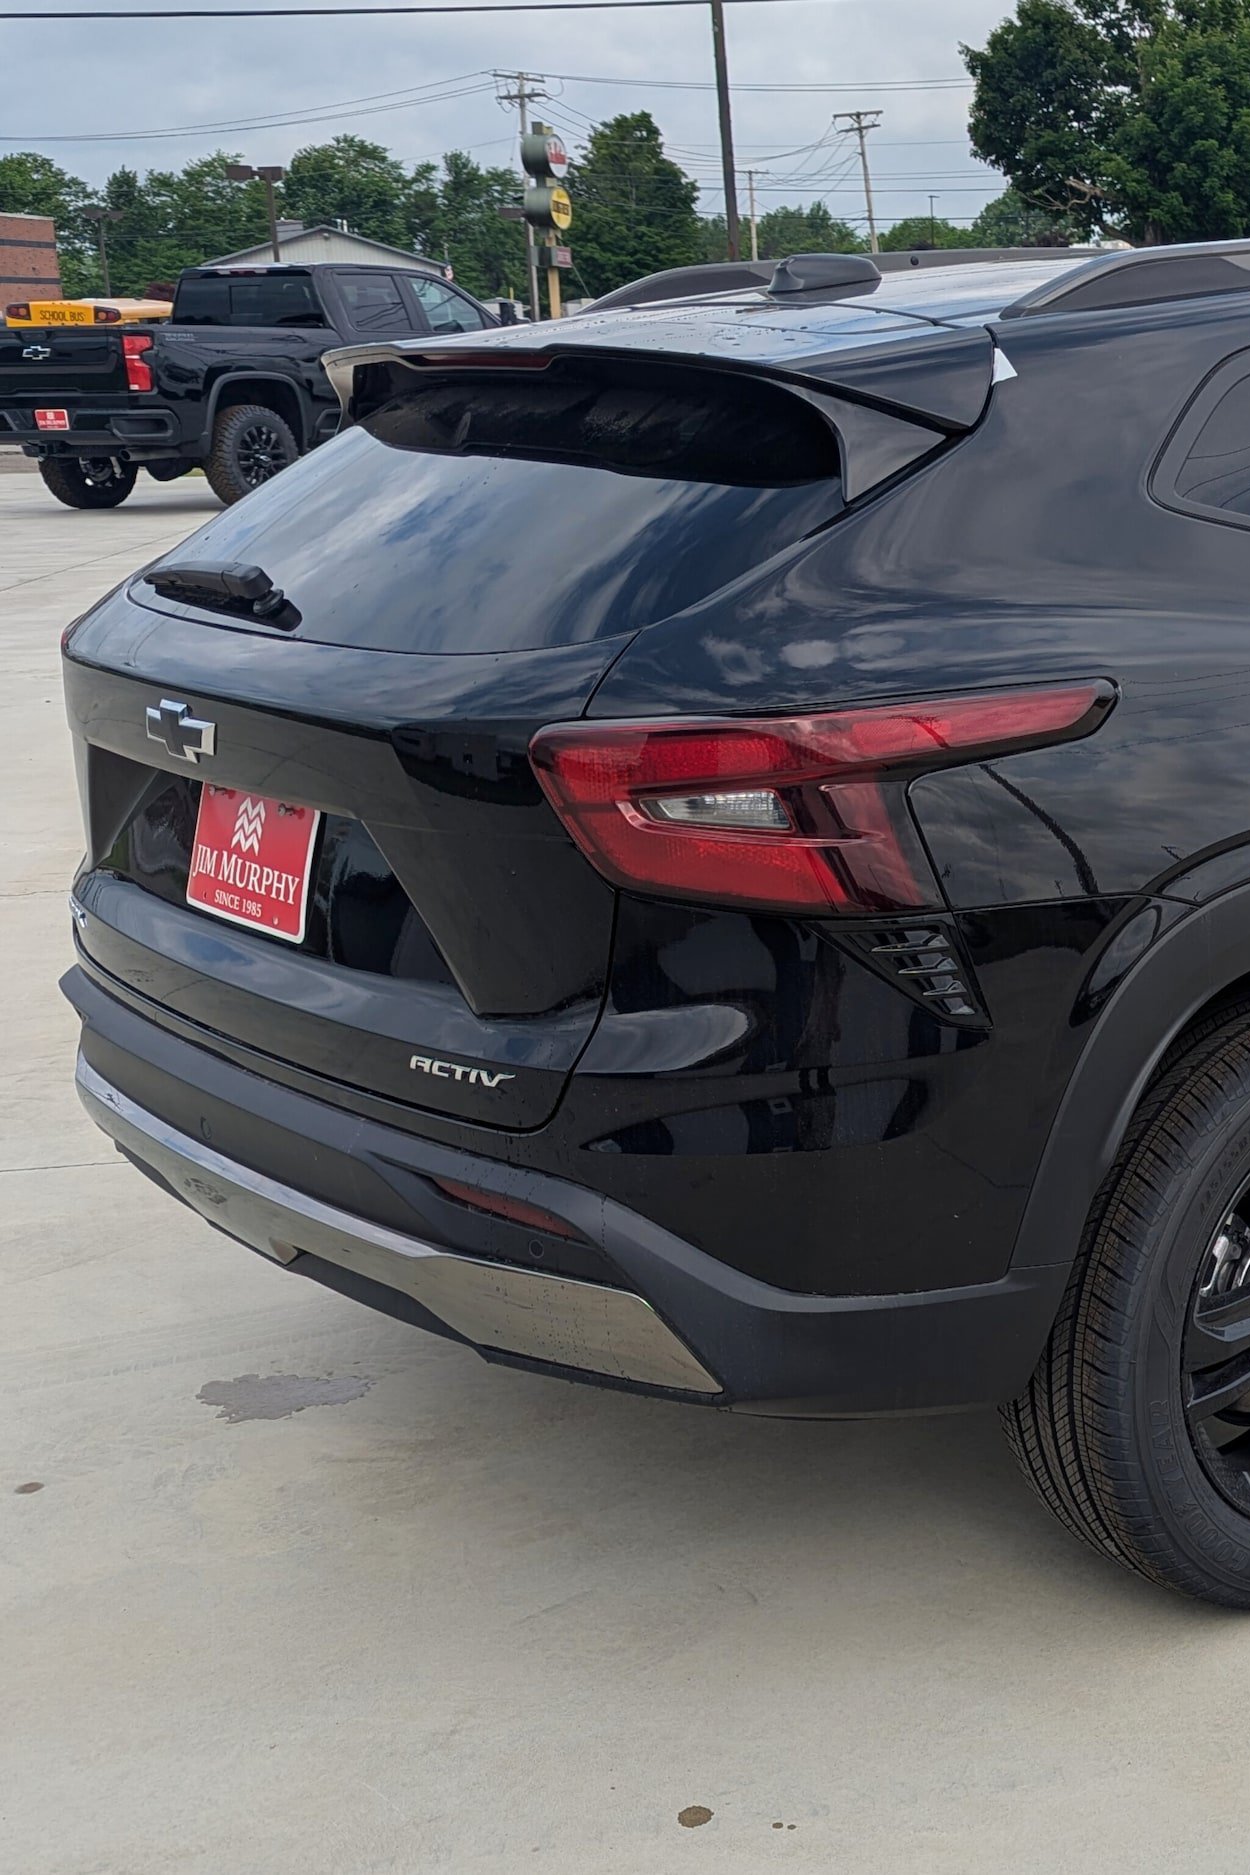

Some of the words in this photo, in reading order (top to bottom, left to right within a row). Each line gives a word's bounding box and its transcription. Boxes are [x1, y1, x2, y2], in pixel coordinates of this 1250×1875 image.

[39, 310, 67, 321] SCHOOL
[69, 311, 85, 322] BUS
[193, 844, 219, 878] JIM
[217, 851, 300, 905] MURPHY
[214, 889, 241, 913] SINCE
[242, 898, 262, 918] 1985
[409, 1055, 516, 1088] ACTIV
[1149, 1400, 1250, 1573] GOODYEAR
